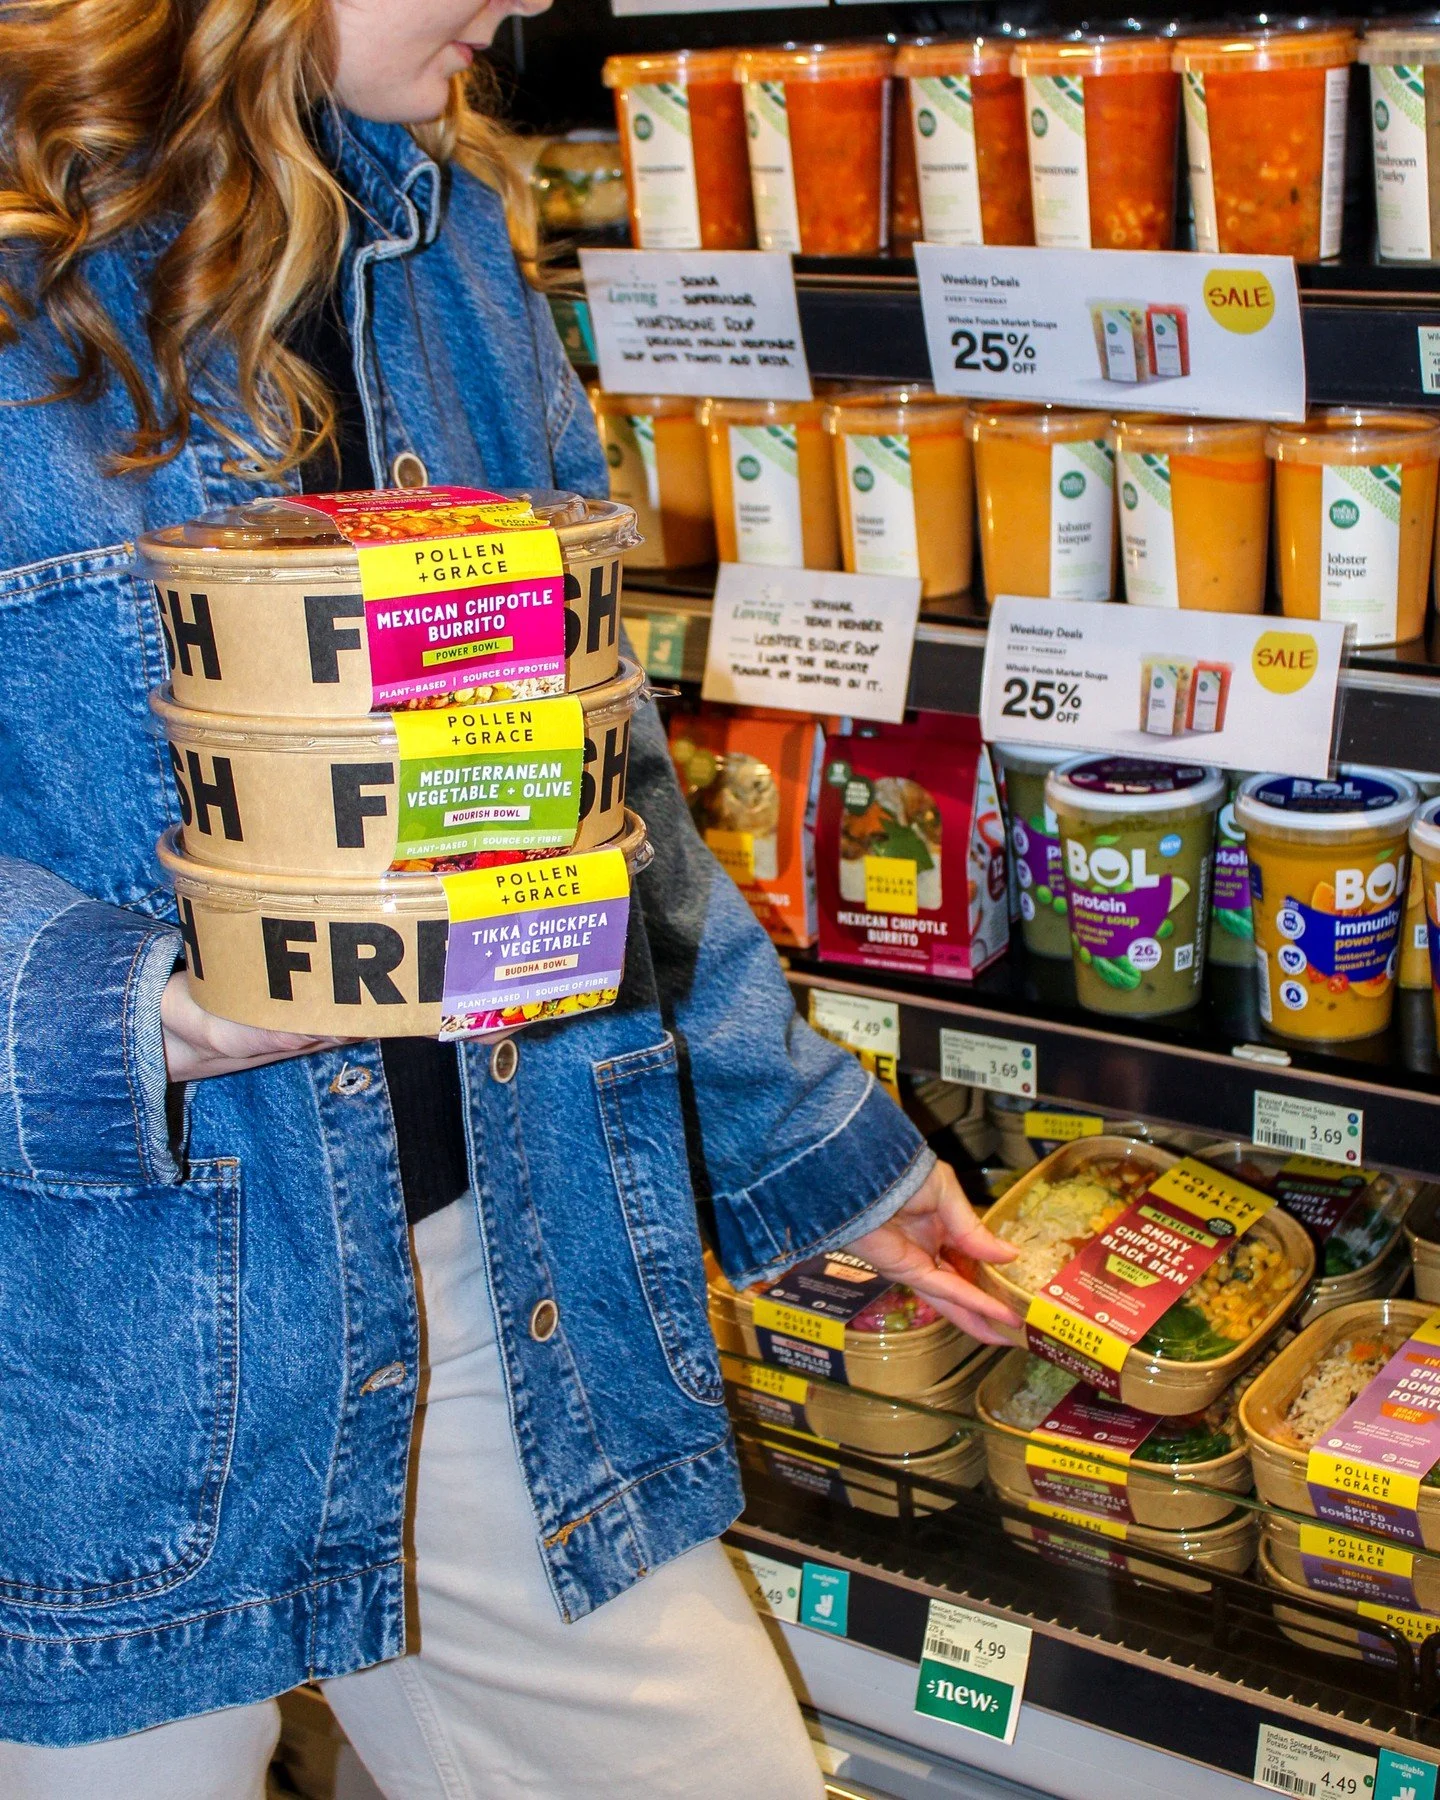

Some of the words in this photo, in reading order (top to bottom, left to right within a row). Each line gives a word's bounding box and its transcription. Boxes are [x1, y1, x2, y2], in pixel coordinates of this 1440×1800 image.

[941, 273, 988, 288] Weekday
[991, 276, 1020, 288] Deals
[1208, 286, 1272, 309] SALE
[948, 316, 974, 325] Whole
[975, 317, 1000, 327] Foods
[1001, 318, 1030, 328] Market
[1033, 319, 1058, 330] Soups
[951, 328, 1036, 373] 25%
[1012, 362, 1037, 374] OFF
[1058, 521, 1092, 533] lobster
[1058, 533, 1092, 546] bisque
[415, 542, 505, 566] POLLEN
[1327, 552, 1368, 566] lobster
[418, 559, 509, 583] +GRACE
[1327, 565, 1367, 580] bisque
[376, 603, 458, 630] MEXICAN
[465, 588, 553, 617] CHIPOTLE
[732, 605, 782, 625] Loving
[428, 614, 506, 642] BURRITO
[837, 618, 883, 633] MEMBER
[1010, 623, 1055, 638] Weekday
[1056, 626, 1084, 640] Deals
[435, 647, 469, 661] POWER
[472, 640, 500, 655] BOWL
[1257, 647, 1314, 669] SALE
[796, 656, 816, 668] THE
[1006, 663, 1031, 674] Whole
[1031, 665, 1054, 675] Foods
[1056, 668, 1083, 679] Market
[1084, 668, 1109, 681] Soups
[379, 679, 448, 700] PLANT-BASED
[462, 668, 501, 684] SOURCE
[502, 667, 517, 676] OF
[518, 661, 560, 675] PROTEIN
[1001, 676, 1082, 720] 25%
[448, 710, 533, 728] POLLEN
[1056, 711, 1080, 724] OFF
[451, 729, 534, 746] +GRACE
[420, 762, 562, 788] MEDITERRANEAN
[407, 783, 500, 808] VEGETABLE
[522, 780, 572, 799] OLIVE
[1292, 779, 1362, 795] BOL
[452, 809, 491, 823] NOURISH
[493, 808, 521, 819] BOWL
[406, 839, 468, 855] PLANT-BASED
[482, 834, 521, 846] SOURCE
[522, 834, 536, 845] OF
[537, 834, 563, 844] FIBRE
[1160, 839, 1182, 851] NEW
[1066, 838, 1160, 889] BOL
[496, 865, 579, 889] POLLEN
[868, 875, 914, 886] POLLEN
[501, 882, 582, 906] +GRACE
[1072, 892, 1127, 914] protein
[472, 924, 521, 946] TIKKA
[528, 912, 608, 936] CHICKPEA
[837, 911, 888, 929] MEXICAN
[890, 917, 948, 936] CHIPOTLE
[1106, 916, 1140, 930] soup
[500, 931, 592, 959] VEGETABLE
[867, 929, 919, 947] BURRITO
[1335, 935, 1375, 951] power
[505, 963, 540, 977] BUDDHA
[543, 958, 568, 971] BOWL
[457, 993, 521, 1010] PLANT-BASED
[535, 984, 570, 997] SOURCE
[571, 982, 583, 992] OF
[584, 976, 609, 989] FIBRE
[852, 1019, 881, 1037] 4.49
[989, 1060, 1018, 1078] 3.69
[1281, 1107, 1300, 1116] Power
[1310, 1125, 1342, 1145] 3.69
[1180, 1169, 1256, 1213] POLLEN
[1152, 1212, 1205, 1242] MEXICAN
[1114, 1225, 1185, 1266] CHIPOTLE
[1141, 1223, 1192, 1253] SMOKY
[1100, 1234, 1148, 1264] BLACK
[1147, 1259, 1189, 1285] BEAN
[776, 1309, 822, 1329] POLLEN
[1054, 1313, 1104, 1345] POLLEN
[1051, 1457, 1101, 1475] +GRACE
[1335, 1463, 1391, 1486] POLLEN
[1334, 1477, 1389, 1498] +GRACE
[1319, 1505, 1365, 1524] BOMBAY
[1369, 1519, 1416, 1538] POTATO
[1344, 1505, 1386, 1522] SPICED
[1328, 1536, 1386, 1556] POLLEN
[1329, 1549, 1385, 1567] +GRACE
[1337, 1576, 1380, 1592] SPICED
[1341, 1568, 1373, 1581] INDIAN
[974, 1638, 1007, 1660] 4.99
[935, 1678, 993, 1712] new
[1266, 1738, 1289, 1751] Potato
[1289, 1744, 1308, 1756] Grain
[1309, 1751, 1326, 1763] Bowl
[1267, 1731, 1289, 1743] Indian
[1289, 1737, 1313, 1751] Spiced
[1313, 1745, 1341, 1761] Bombay
[1267, 1754, 1279, 1764] 275
[1390, 1761, 1425, 1777] available
[1320, 1771, 1357, 1795] 4.49
[1401, 1770, 1412, 1779] on
